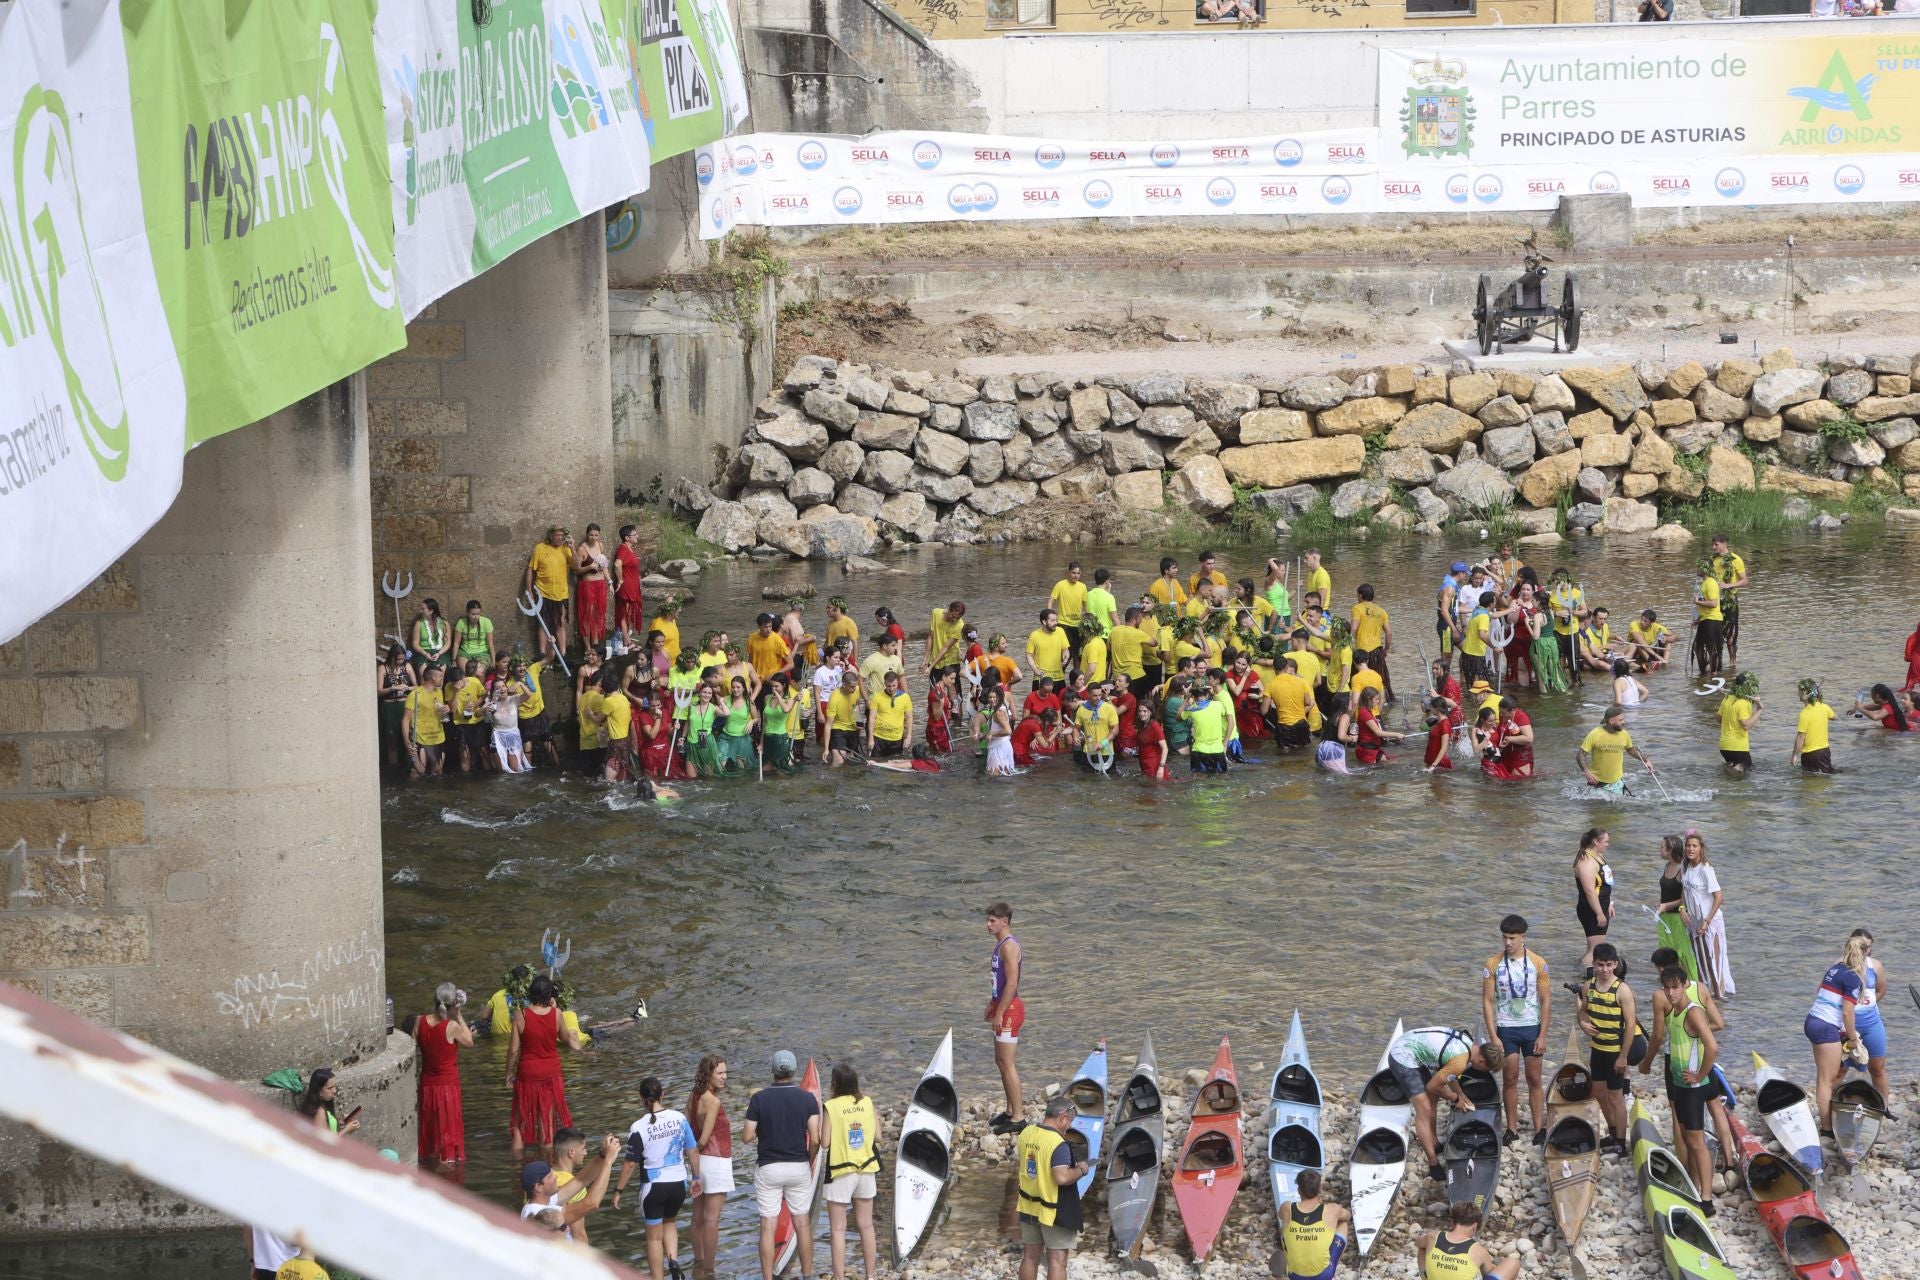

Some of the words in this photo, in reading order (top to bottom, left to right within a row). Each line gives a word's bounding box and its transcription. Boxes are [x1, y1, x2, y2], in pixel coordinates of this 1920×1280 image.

[1876, 58, 1899, 71] TU
[1499, 54, 1701, 90] Ayuntamiento
[1711, 52, 1747, 78] de
[461, 10, 546, 153] PARAÍSO
[1500, 95, 1597, 120] Parres
[1500, 130, 1615, 148] PRINCIPADO
[1620, 130, 1646, 145] DE
[1650, 126, 1747, 144] ASTURIAS
[1779, 123, 1902, 146] ARRIONDAS
[852, 150, 889, 160] SELLA
[974, 151, 1012, 160] SELLA
[1089, 151, 1127, 160] SELLA
[1212, 149, 1250, 159] SELLA
[1328, 147, 1366, 157] SELLA
[1653, 178, 1691, 189] SELLA
[1770, 175, 1809, 186] SELLA
[1145, 187, 1183, 198] SELLA
[1260, 186, 1298, 197] SELLA
[1384, 184, 1421, 194] SELLA
[1528, 182, 1565, 192] SELLA
[887, 195, 924, 205] SELLA
[1023, 191, 1060, 201] SELLA
[772, 198, 809, 208] SELLA
[231, 266, 306, 334] Reciclamos
[647, 1119, 681, 1135] GALICIA
[1441, 1254, 1469, 1266] Cuervos
[1436, 1261, 1459, 1272] Pravia
